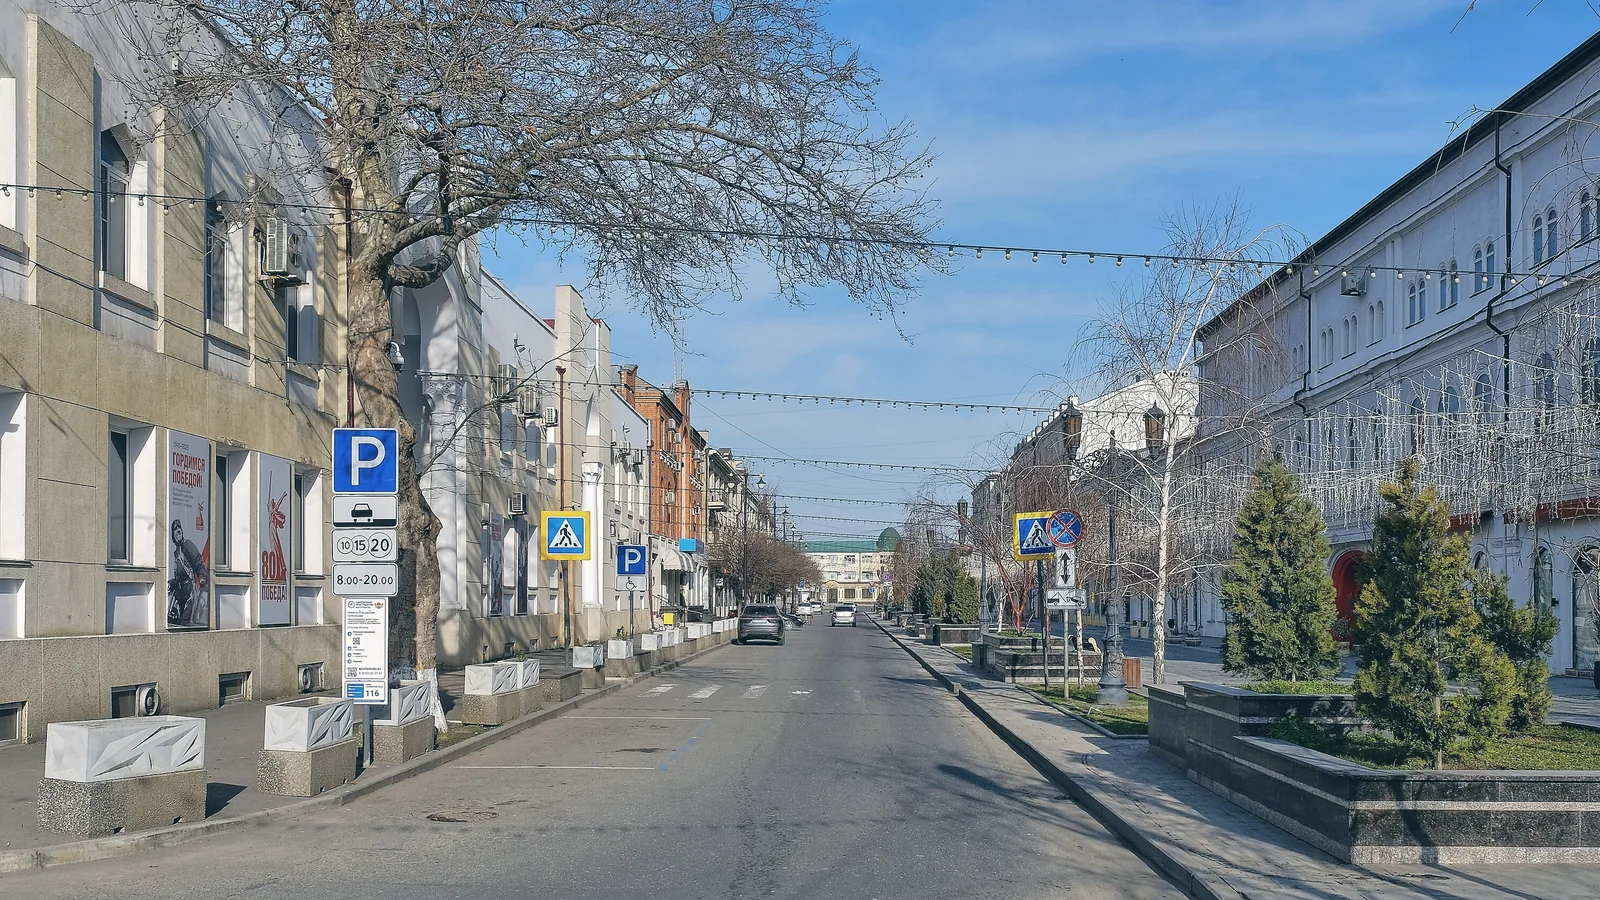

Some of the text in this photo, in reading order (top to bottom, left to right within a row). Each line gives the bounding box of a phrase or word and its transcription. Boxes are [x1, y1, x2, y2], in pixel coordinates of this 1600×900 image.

[172, 451, 206, 472] ГОРДИМСЯ
[351, 436, 386, 486] P
[172, 469, 203, 488] ПОБЕДОЙ!
[340, 538, 389, 552] 10 15 20
[262, 550, 276, 580] 80
[624, 548, 642, 572] P
[337, 574, 394, 585] 8.00-20.00
[261, 585, 288, 602] ПОБЕДА!
